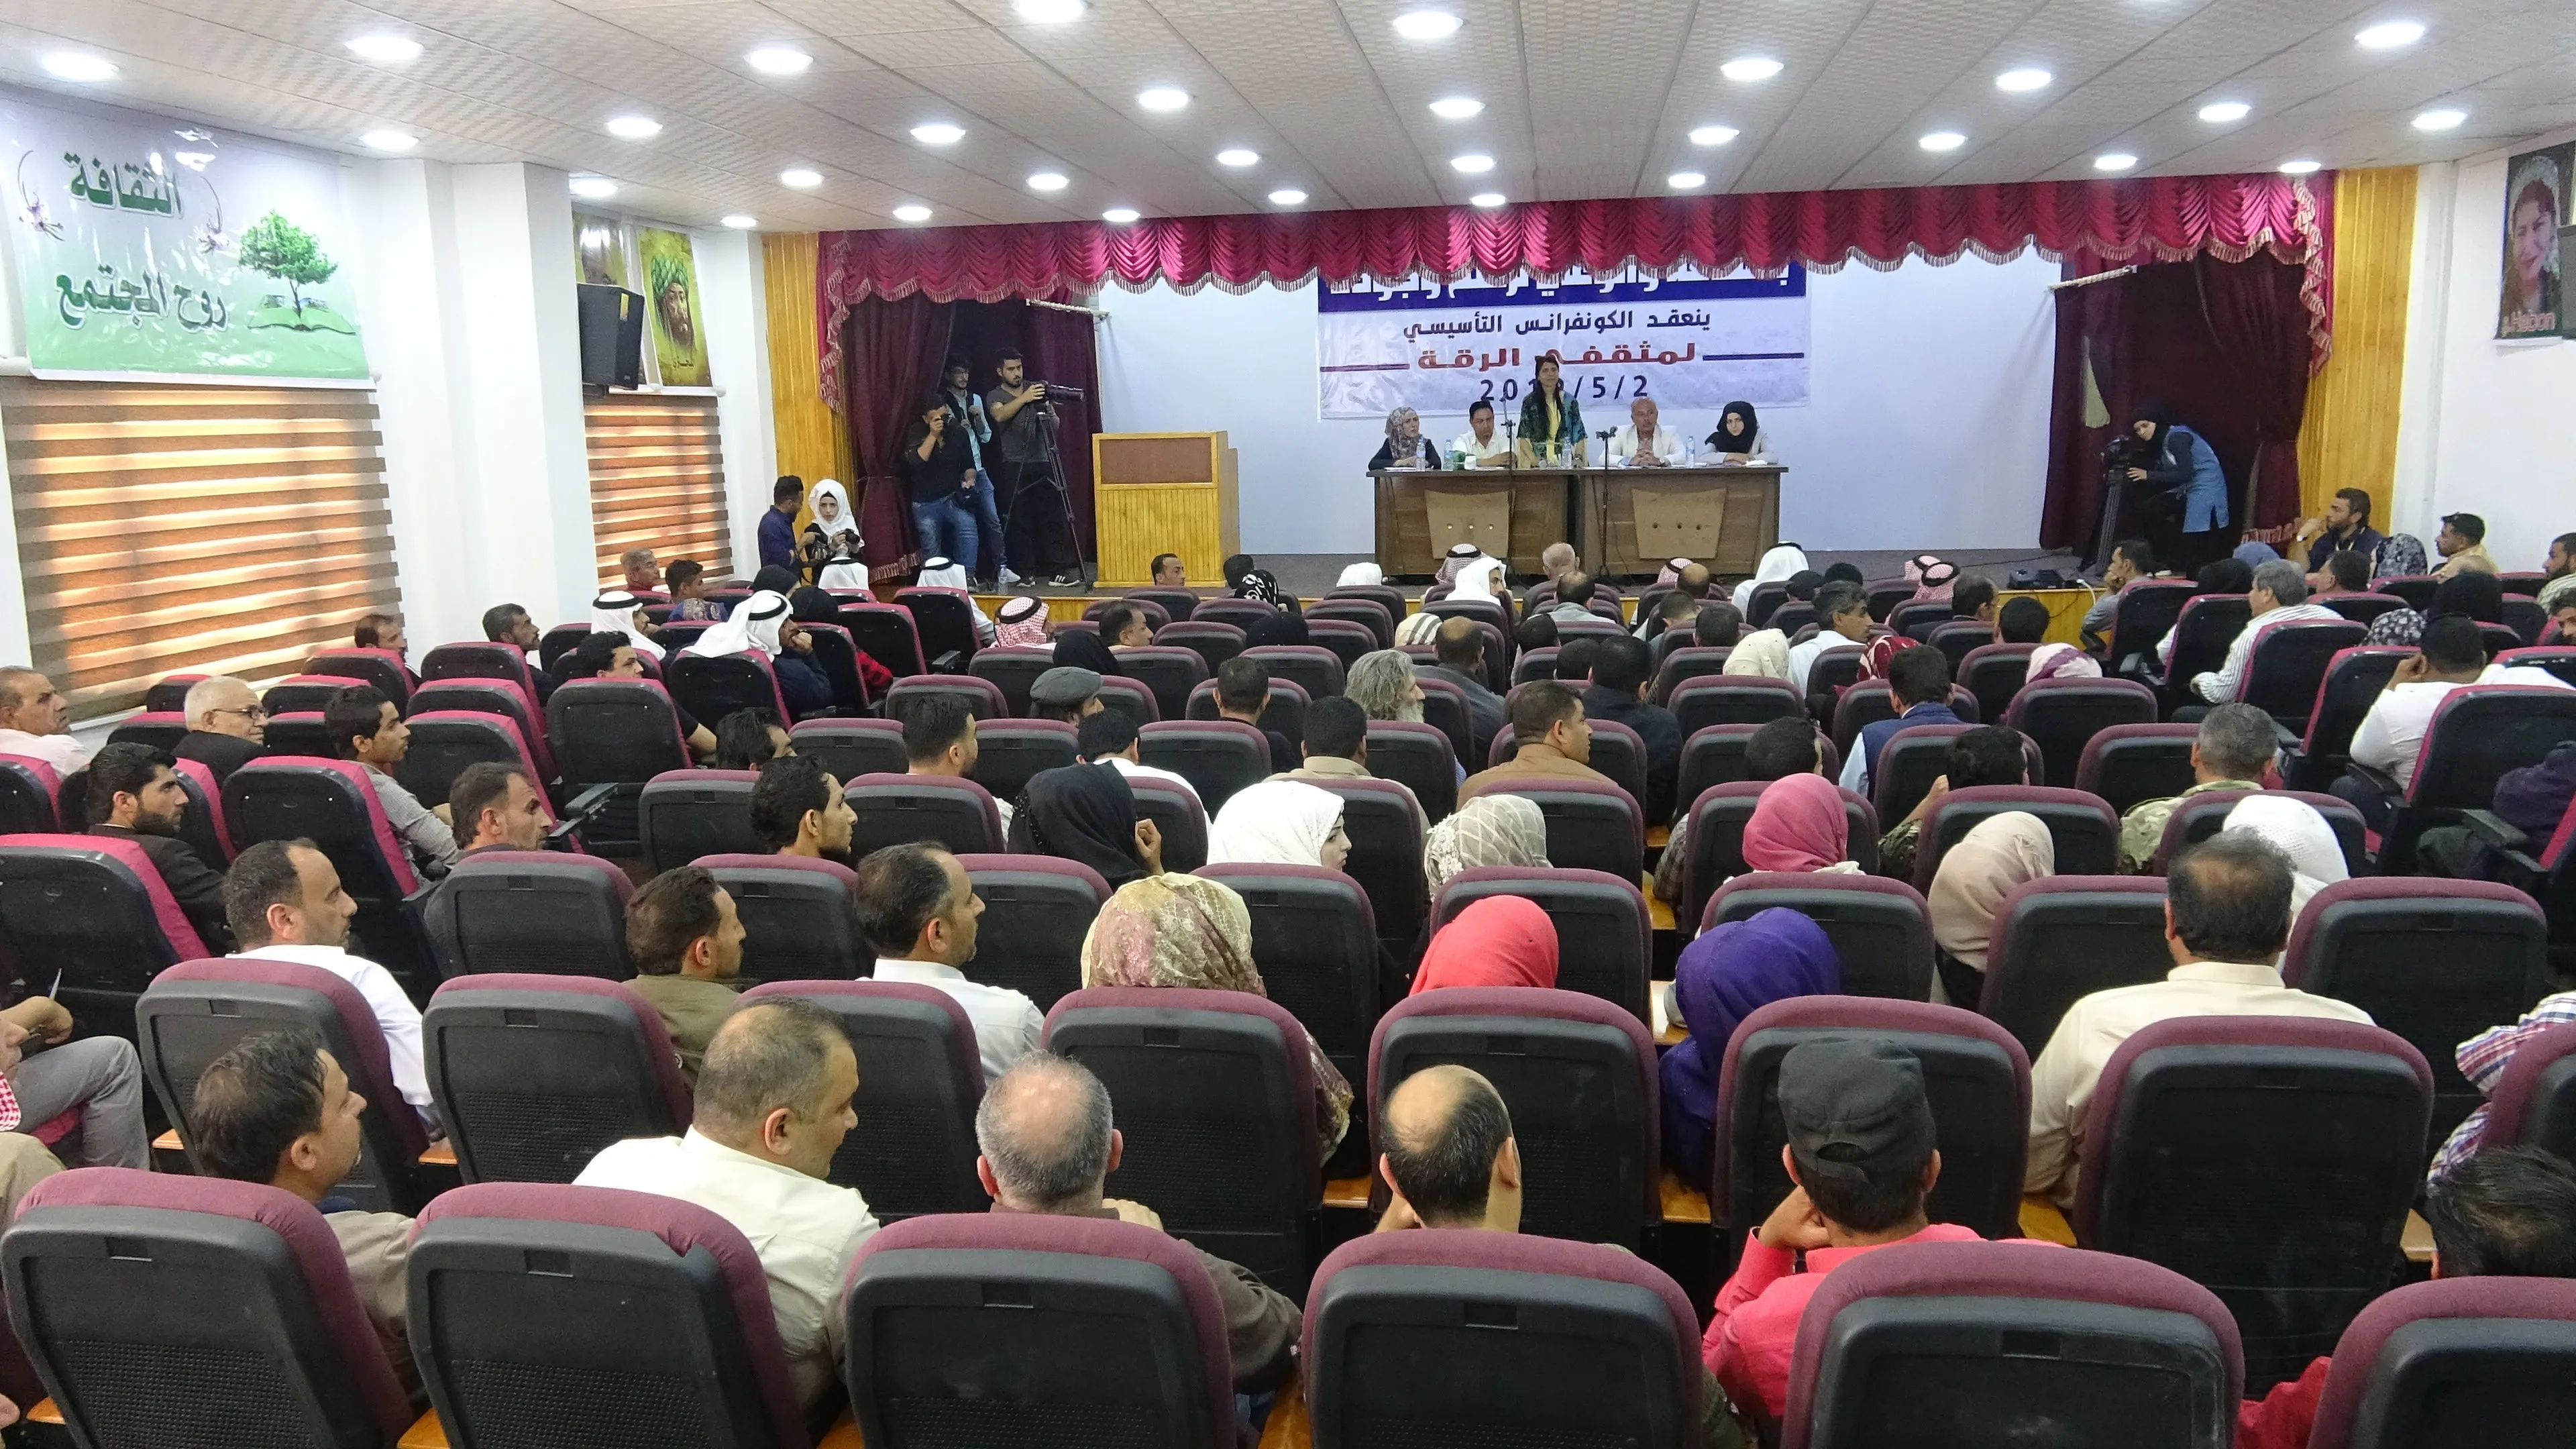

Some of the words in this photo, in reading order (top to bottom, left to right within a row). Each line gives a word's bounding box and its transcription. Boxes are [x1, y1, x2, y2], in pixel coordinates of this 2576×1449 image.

[63, 150, 185, 219] الثقافة
[55, 263, 172, 331] المجتمع
[173, 283, 231, 334] روح
[1403, 311, 1503, 342] التأسيسي
[1516, 310, 1633, 334] الكونفرانس
[1646, 309, 1711, 331] ينعقد
[1416, 348, 1519, 372] الرقة
